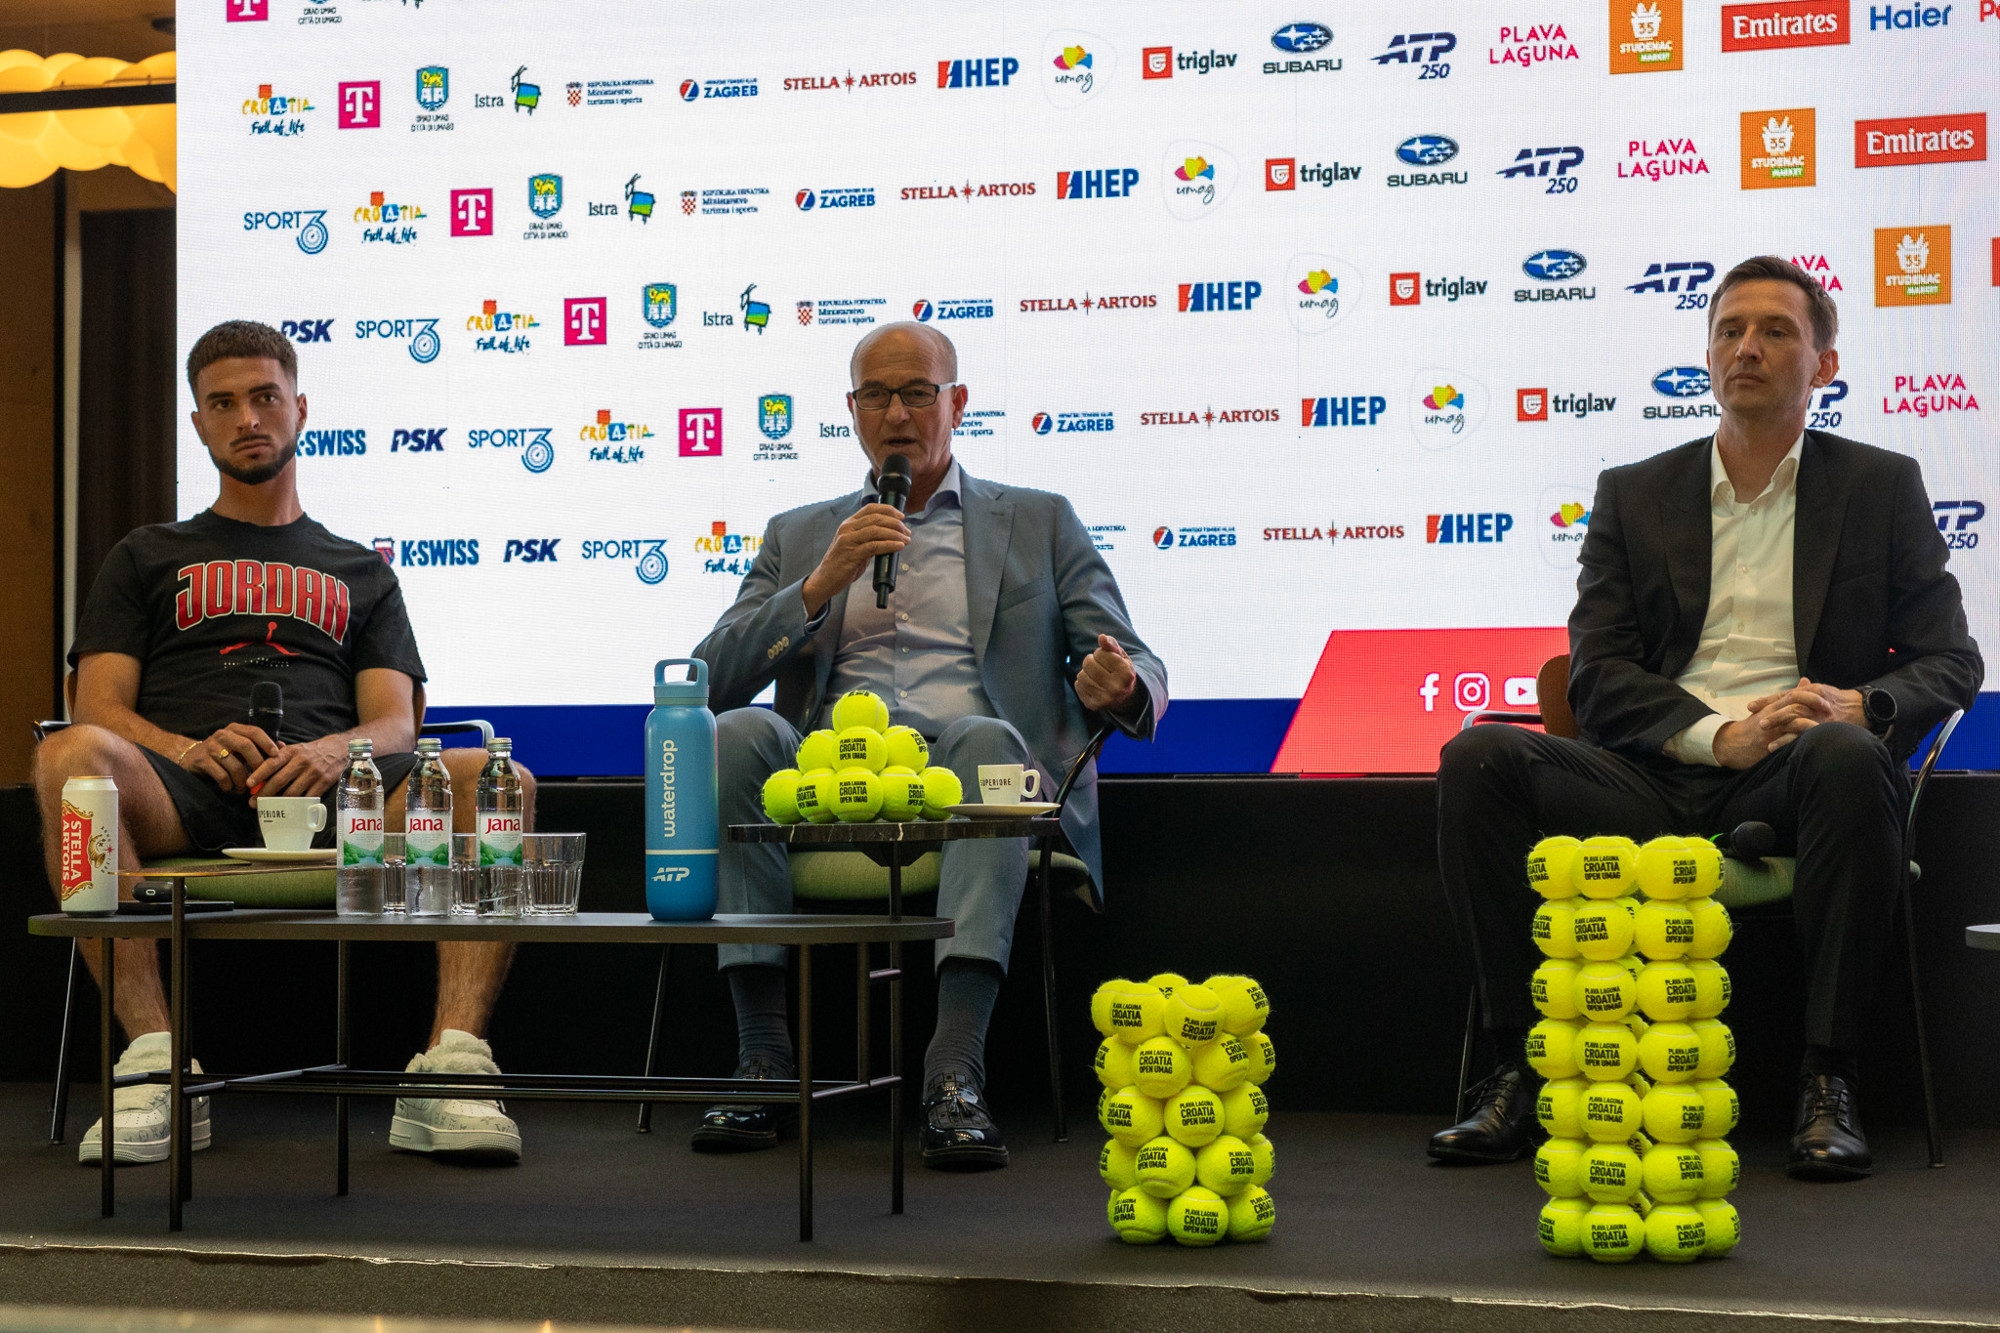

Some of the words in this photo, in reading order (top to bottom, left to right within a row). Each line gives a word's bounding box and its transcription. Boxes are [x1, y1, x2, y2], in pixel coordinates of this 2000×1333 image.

[1870, 2, 1951, 31] Haier
[1501, 24, 1567, 43] PLAVA
[1733, 13, 1837, 39] Emirates
[1370, 32, 1456, 64] ATP
[1490, 44, 1579, 67] LAGUNA
[1620, 41, 1672, 53] STUDENAC
[1177, 50, 1237, 74] triglav
[1263, 59, 1342, 74] SUBARU
[965, 57, 1019, 88] HEP
[1418, 64, 1450, 80] 250
[784, 77, 839, 90] STELLA
[859, 72, 916, 87] ARTOIS
[704, 85, 758, 98] ZAGREB
[242, 97, 315, 115] CROATIA
[475, 94, 504, 108] Istra
[1629, 139, 1696, 157] PLAVA
[1866, 128, 1974, 155] Emirates
[1496, 146, 1584, 178] ATP
[1618, 158, 1710, 181] LAGUNA
[1752, 156, 1804, 168] STUDENAC
[1086, 168, 1139, 198] HEP
[1300, 162, 1362, 187] triglav
[1387, 172, 1468, 187] SUBARU
[901, 186, 958, 200] STELLA
[977, 183, 1036, 196] ARTOIS
[1546, 178, 1578, 194] 250
[589, 202, 618, 216] Istra
[820, 194, 875, 208] ZAGREB
[354, 204, 427, 223] CROATIA
[1625, 261, 1715, 294] ATP
[1207, 281, 1262, 311] HEP
[1426, 276, 1488, 302] triglav
[1514, 287, 1595, 302] SUBARU
[1021, 299, 1077, 312] STELLA
[1097, 295, 1156, 309] ARTOIS
[1676, 293, 1708, 310] 250
[704, 312, 733, 326] Istra
[938, 306, 993, 319] ZAGREB
[467, 313, 540, 331] CROATIA
[282, 319, 334, 343] PSK
[1895, 374, 1966, 393] PLAVA
[1331, 396, 1386, 426] HEP
[1553, 393, 1616, 418] triglav
[1884, 394, 1980, 418] LAGUNA
[1057, 418, 1114, 432] ZAGREB
[1141, 412, 1199, 425] STELLA
[1219, 409, 1279, 423] ARTOIS
[1809, 412, 1842, 428] 250
[580, 423, 654, 441] CROATIA
[819, 422, 850, 438] Istra
[391, 428, 447, 452] PSK
[1933, 500, 1984, 531] TP
[1264, 528, 1322, 541] STELLA
[1343, 526, 1404, 539] ARTOIS
[1456, 513, 1513, 543] HEP
[1178, 534, 1236, 547] ZAGREB
[1946, 534, 1978, 550] 250
[503, 539, 561, 563] PSK
[176, 559, 350, 646] JORDAN
[840, 743, 866, 752] CROATIA
[660, 739, 678, 838] waterdrop
[840, 787, 867, 796] CROATIA
[71, 820, 82, 880] STELLA
[651, 867, 690, 882] ATP
[1584, 862, 1620, 872] CROATIA
[1140, 1056, 1172, 1066] CROATIA
[1585, 1049, 1620, 1059] CROATIA
[1181, 1107, 1215, 1118] CROATIA
[1182, 1118, 1198, 1126] OPEN
[1590, 1166, 1626, 1178] CROATIA
[1590, 1176, 1605, 1184] OPEN
[1606, 1178, 1626, 1186] UMAG
